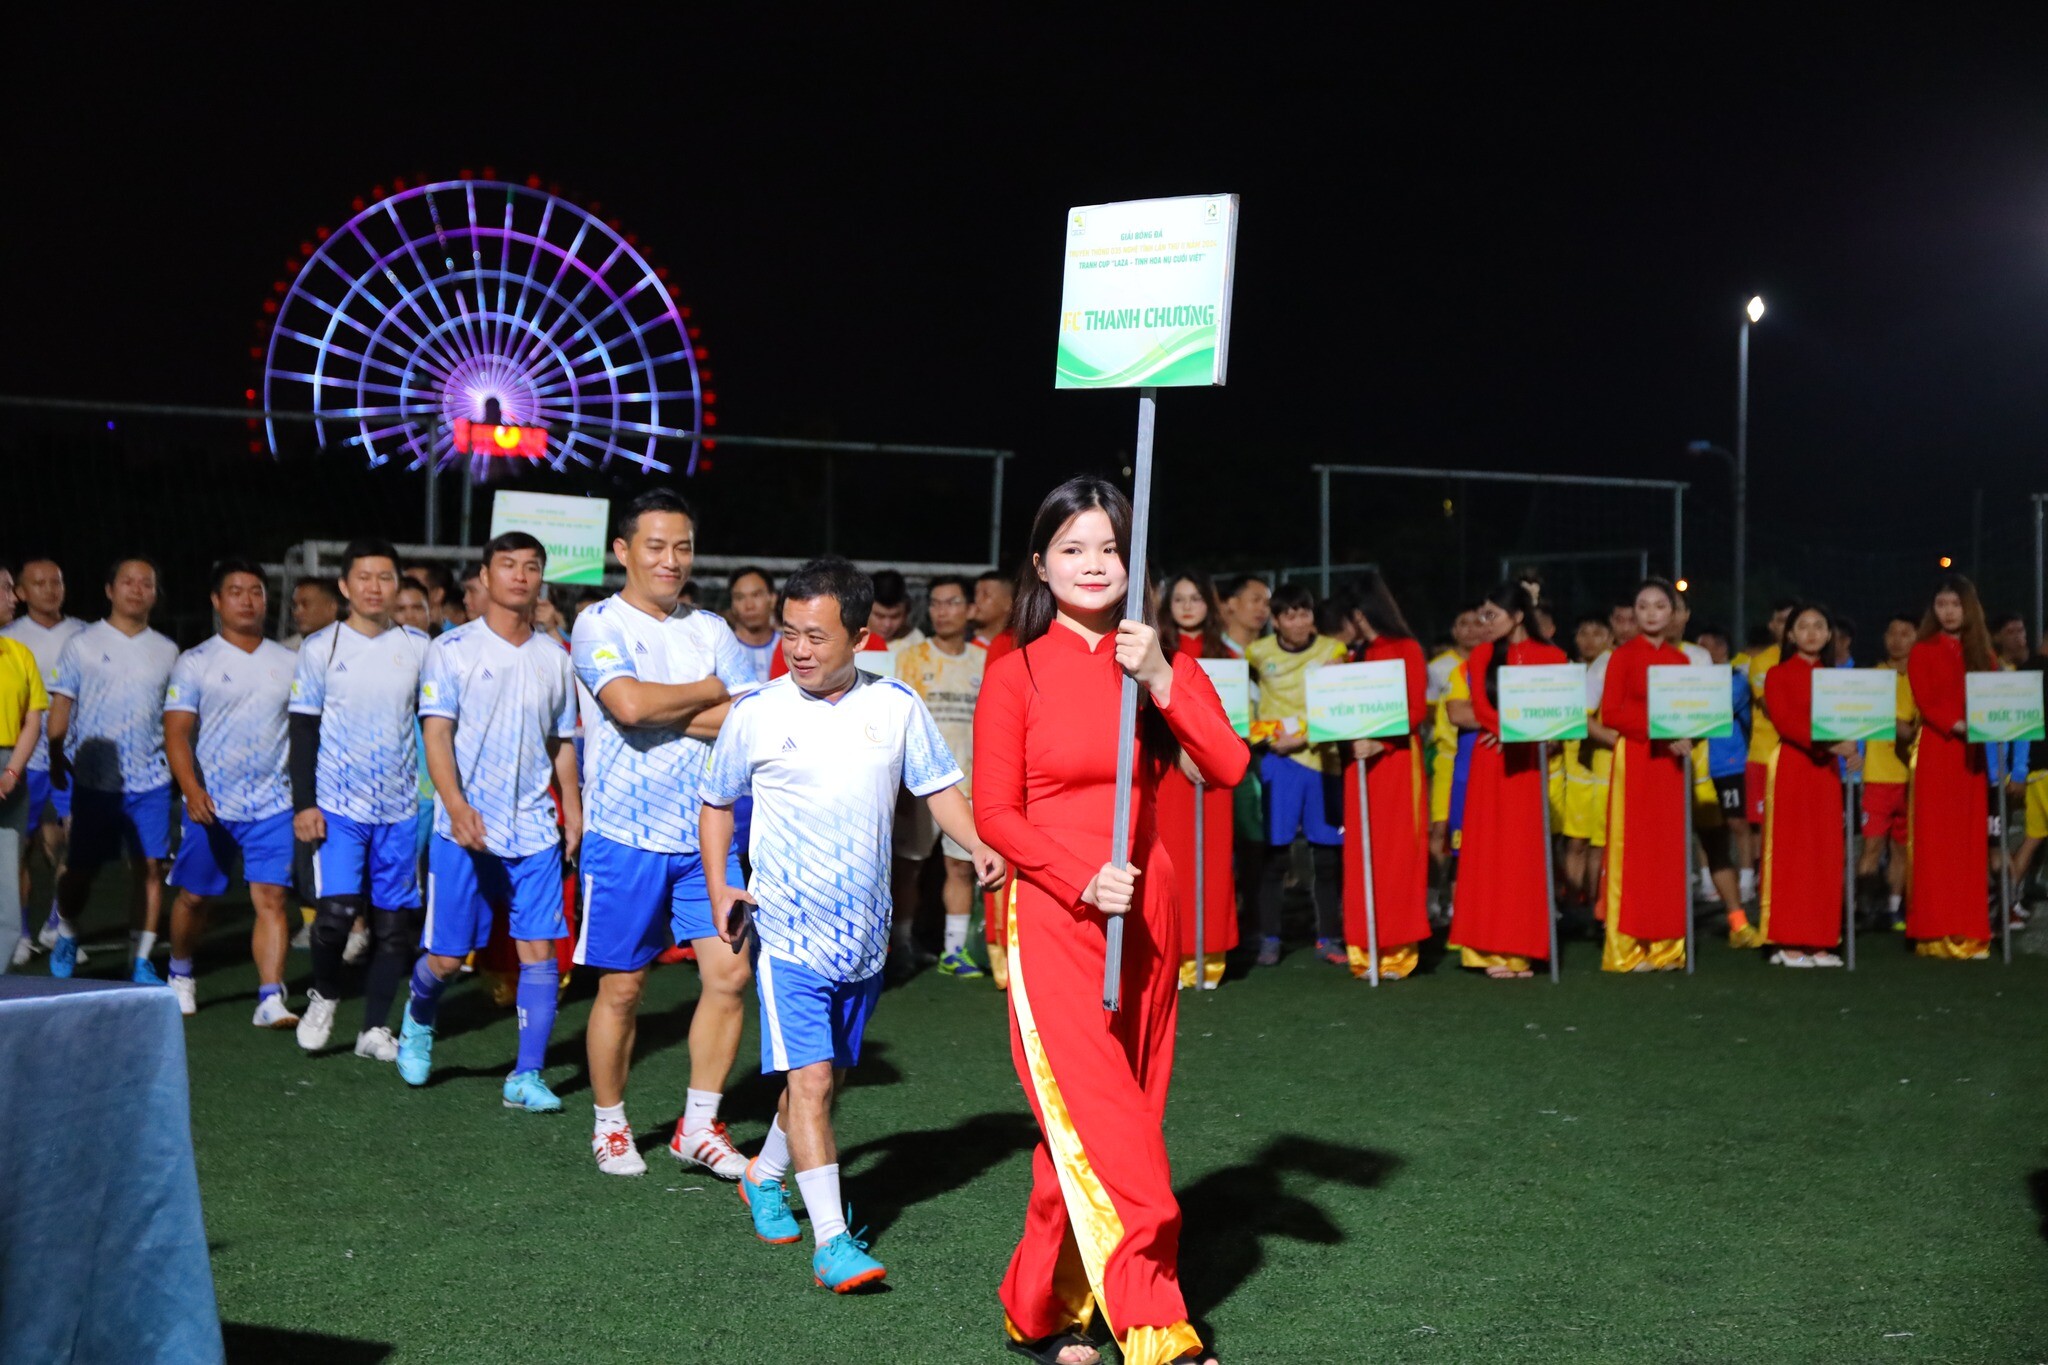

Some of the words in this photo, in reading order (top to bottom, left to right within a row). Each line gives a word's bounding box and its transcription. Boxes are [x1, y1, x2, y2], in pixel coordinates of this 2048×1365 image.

[1063, 311, 1082, 332] FC
[1085, 308, 1141, 331] THANH
[1144, 304, 1215, 328] CHƯƠNG
[1723, 788, 1740, 808] 21
